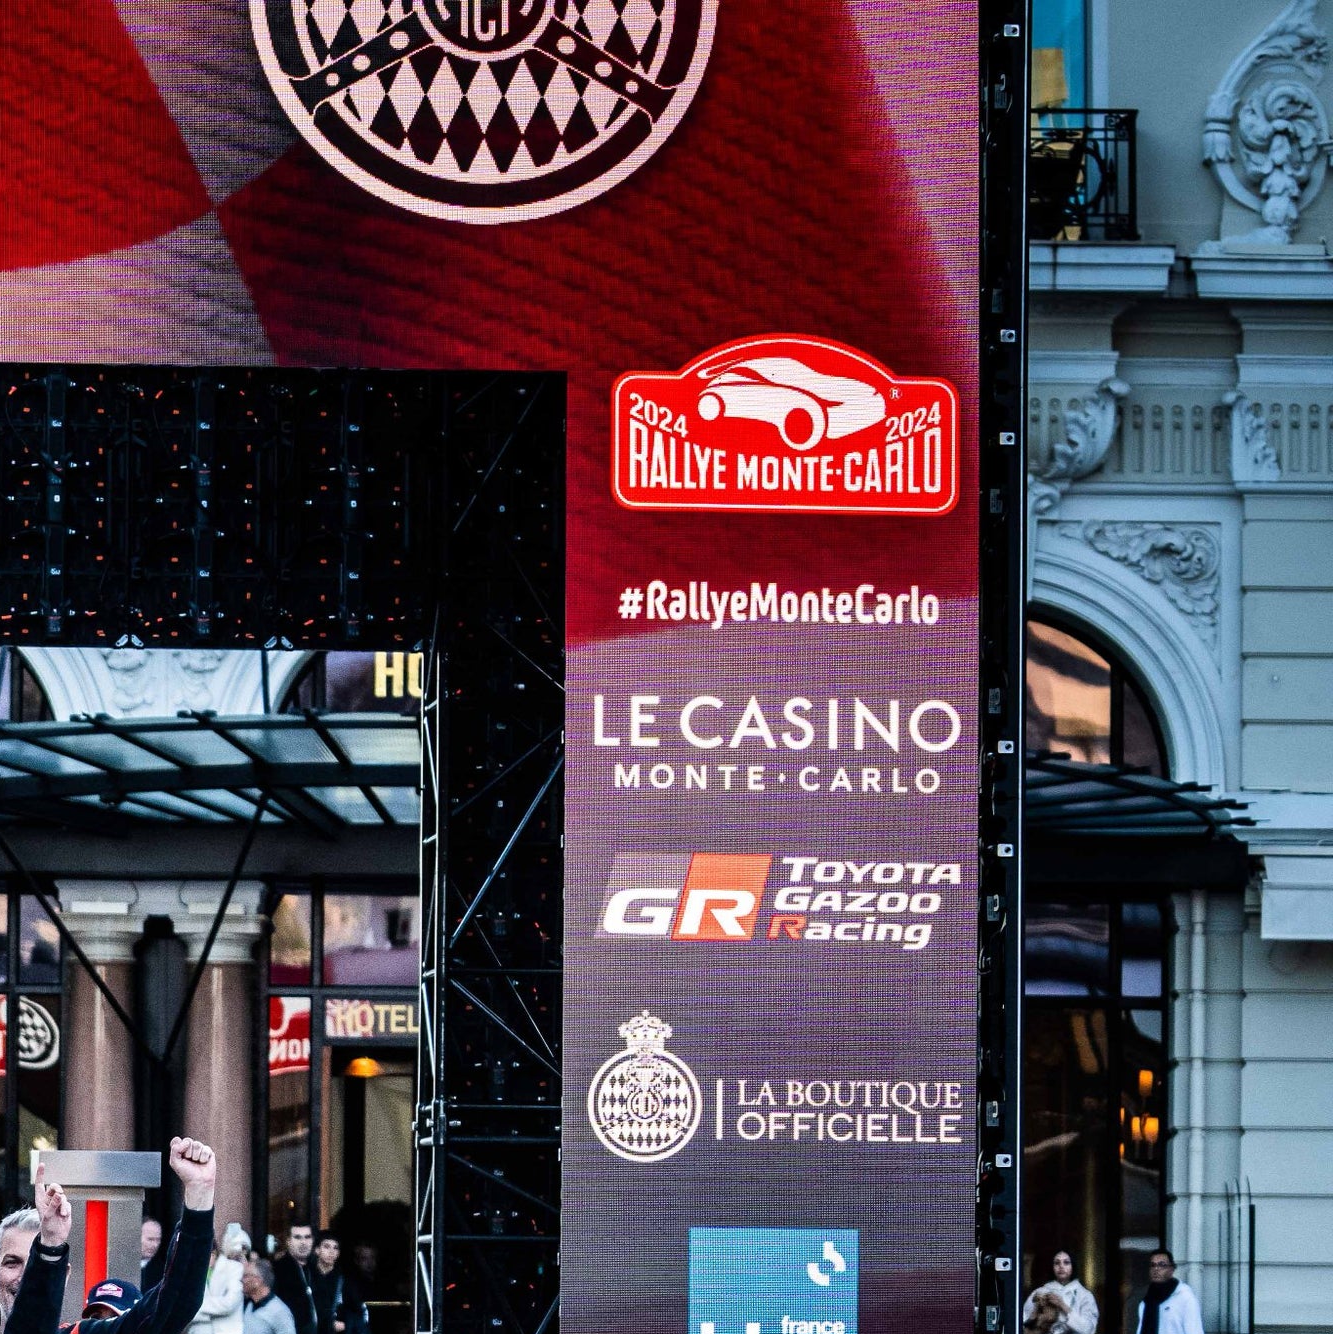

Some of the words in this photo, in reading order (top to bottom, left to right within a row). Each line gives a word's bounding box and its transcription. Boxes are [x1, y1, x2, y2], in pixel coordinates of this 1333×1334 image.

[629, 392, 689, 438] 2024
[884, 401, 942, 443] 2024
[628, 418, 727, 490] RALLYE
[737, 427, 942, 494] MONTE-CARLO
[618, 580, 941, 630] #RallyeMonteCarlo
[593, 694, 661, 747] LE
[679, 694, 963, 753] CASINO
[781, 856, 962, 885] TOYOTA
[601, 887, 757, 936] GR
[774, 887, 942, 914] GAZOO
[767, 915, 933, 949] Racing
[737, 1079, 779, 1106] LA
[791, 1079, 963, 1115] BOUTIQUE
[736, 1112, 963, 1142] OFFICIELLE
